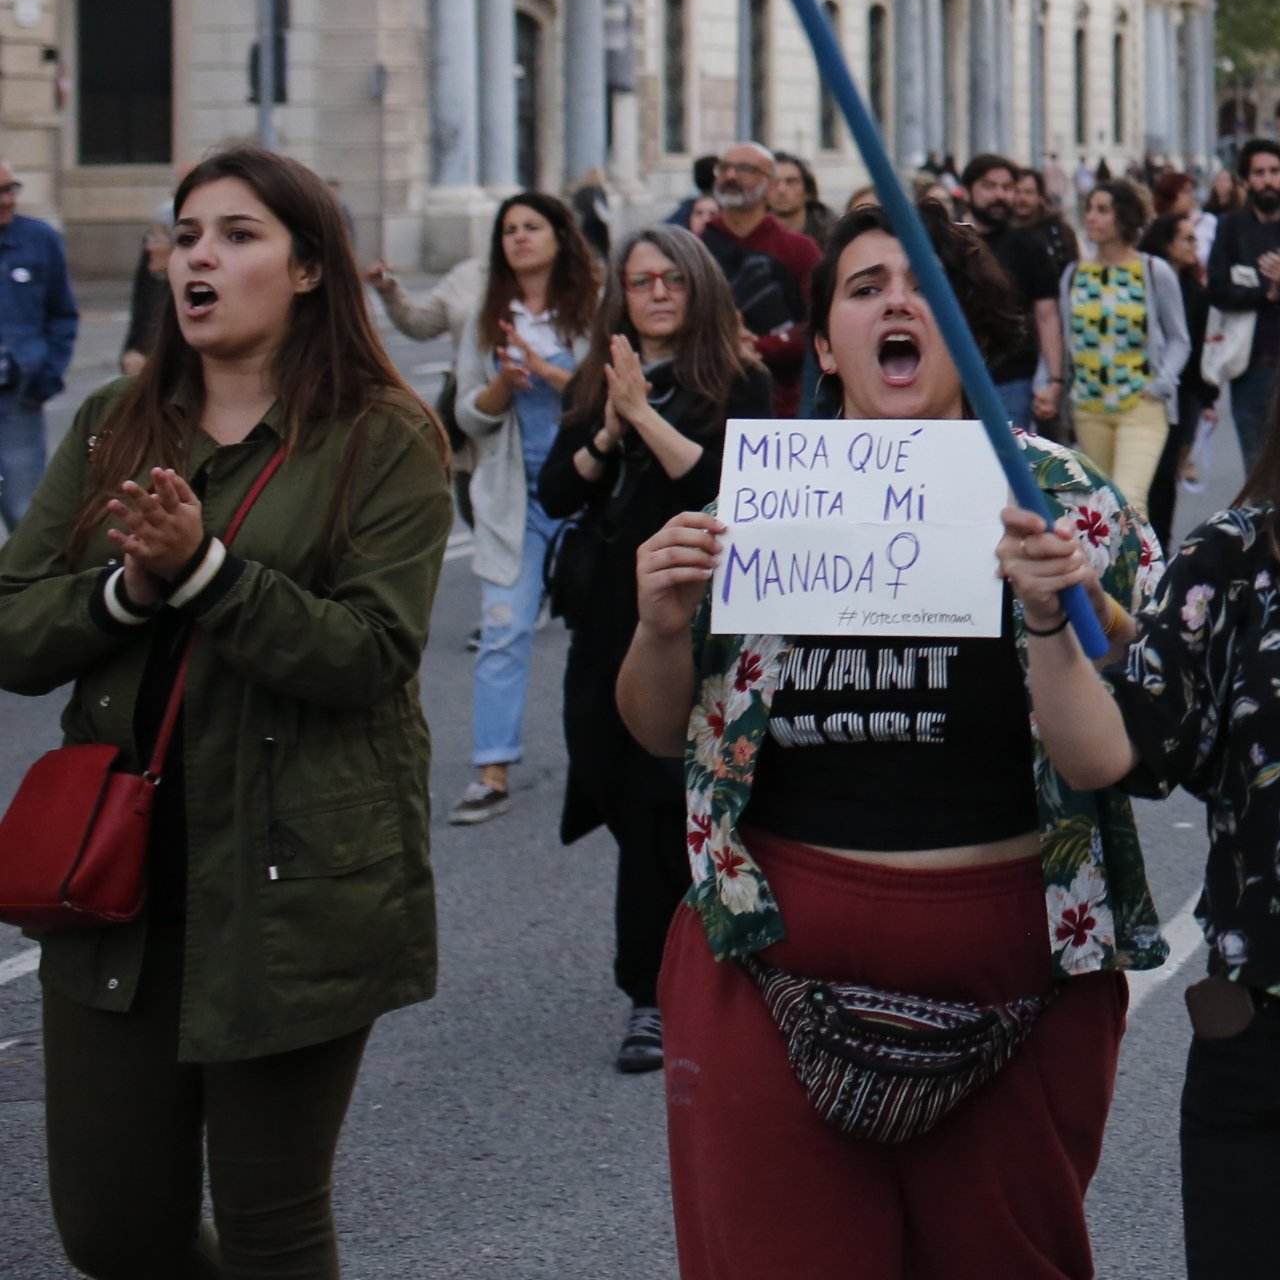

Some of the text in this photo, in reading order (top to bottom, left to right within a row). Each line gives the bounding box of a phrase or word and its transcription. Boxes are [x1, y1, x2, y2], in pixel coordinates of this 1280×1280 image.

[848, 427, 923, 474] QUÉ
[721, 542, 875, 605] MANADA
[768, 711, 947, 748] MORE
